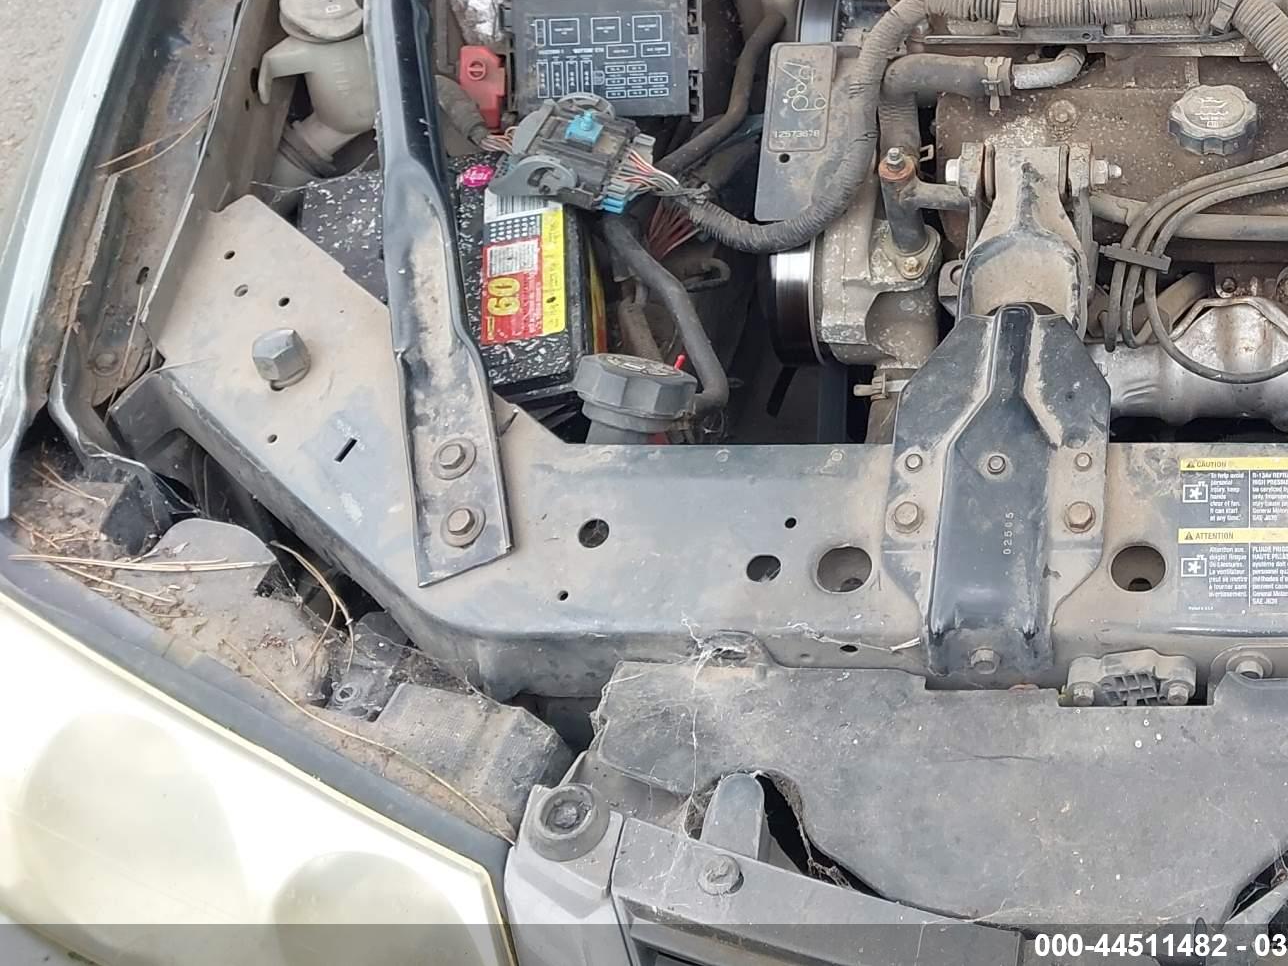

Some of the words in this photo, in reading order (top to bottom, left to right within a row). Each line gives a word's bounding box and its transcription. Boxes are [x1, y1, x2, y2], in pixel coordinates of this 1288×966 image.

[1196, 461, 1227, 469] CAUTION
[1002, 512, 1014, 555] 02505
[1195, 532, 1234, 540] ATTENTION
